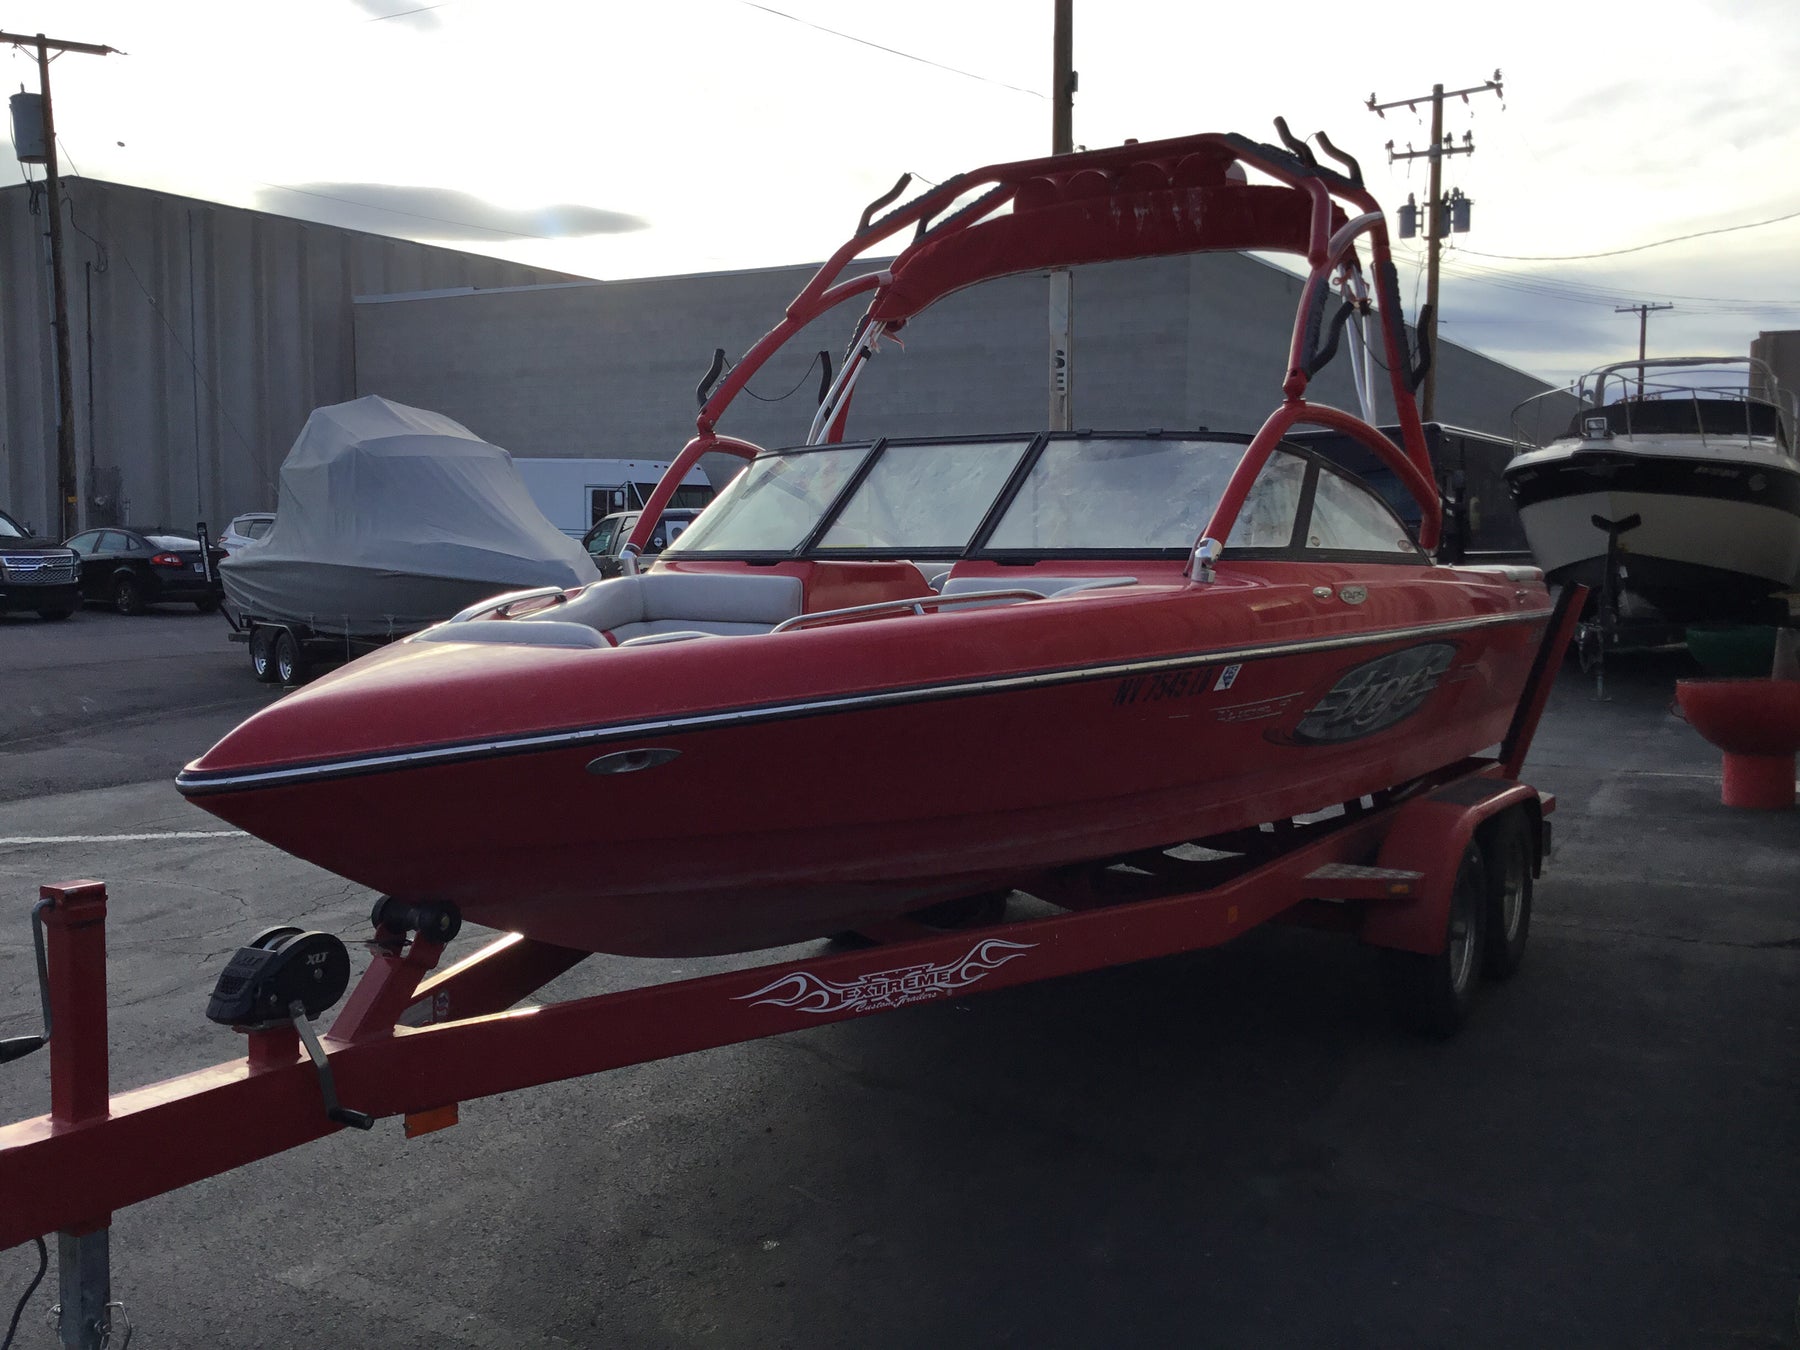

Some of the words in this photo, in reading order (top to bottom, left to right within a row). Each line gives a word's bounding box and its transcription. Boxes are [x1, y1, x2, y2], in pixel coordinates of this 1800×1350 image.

[306, 951, 329, 965] XLT
[841, 970, 952, 1003] EXTREME
[855, 999, 894, 1013] Custom
[892, 991, 938, 1008] Trailers
